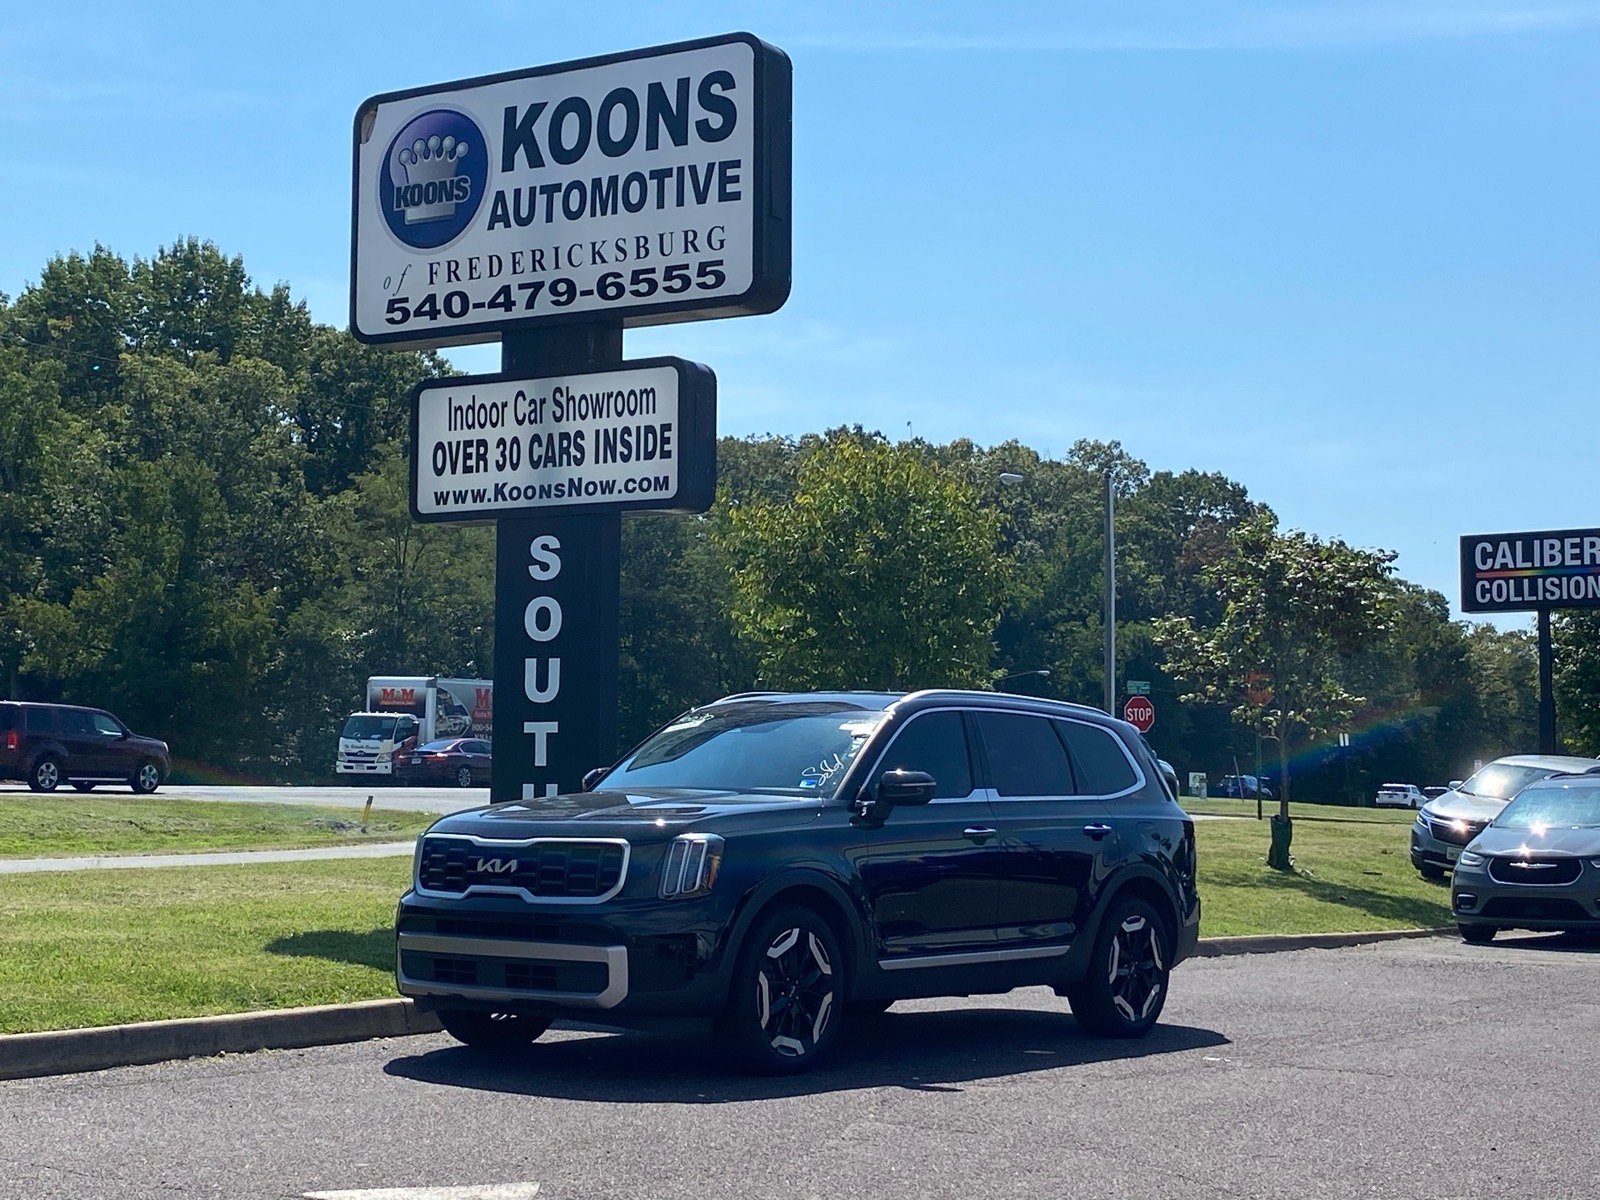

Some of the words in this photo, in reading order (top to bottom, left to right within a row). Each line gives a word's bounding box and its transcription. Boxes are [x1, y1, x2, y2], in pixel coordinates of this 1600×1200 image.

[500, 70, 738, 173] KOONS
[394, 176, 470, 210] KOONS
[487, 159, 742, 231] AUTOMOTIVE
[383, 264, 412, 296] of
[428, 225, 727, 286] FREDERICKSBURG
[385, 259, 726, 325] 540-479-6555
[448, 395, 508, 431] Indoor
[514, 390, 546, 426] Car
[552, 386, 656, 423] Showroom
[432, 439, 488, 477] OVER
[495, 437, 521, 471] 30
[528, 430, 585, 470] CARS
[594, 423, 672, 465] INSIDE
[1474, 536, 1600, 571] CALIBER
[1475, 576, 1600, 603] COLLISION
[1127, 708, 1151, 721] STOP
[477, 858, 518, 873] KIA
